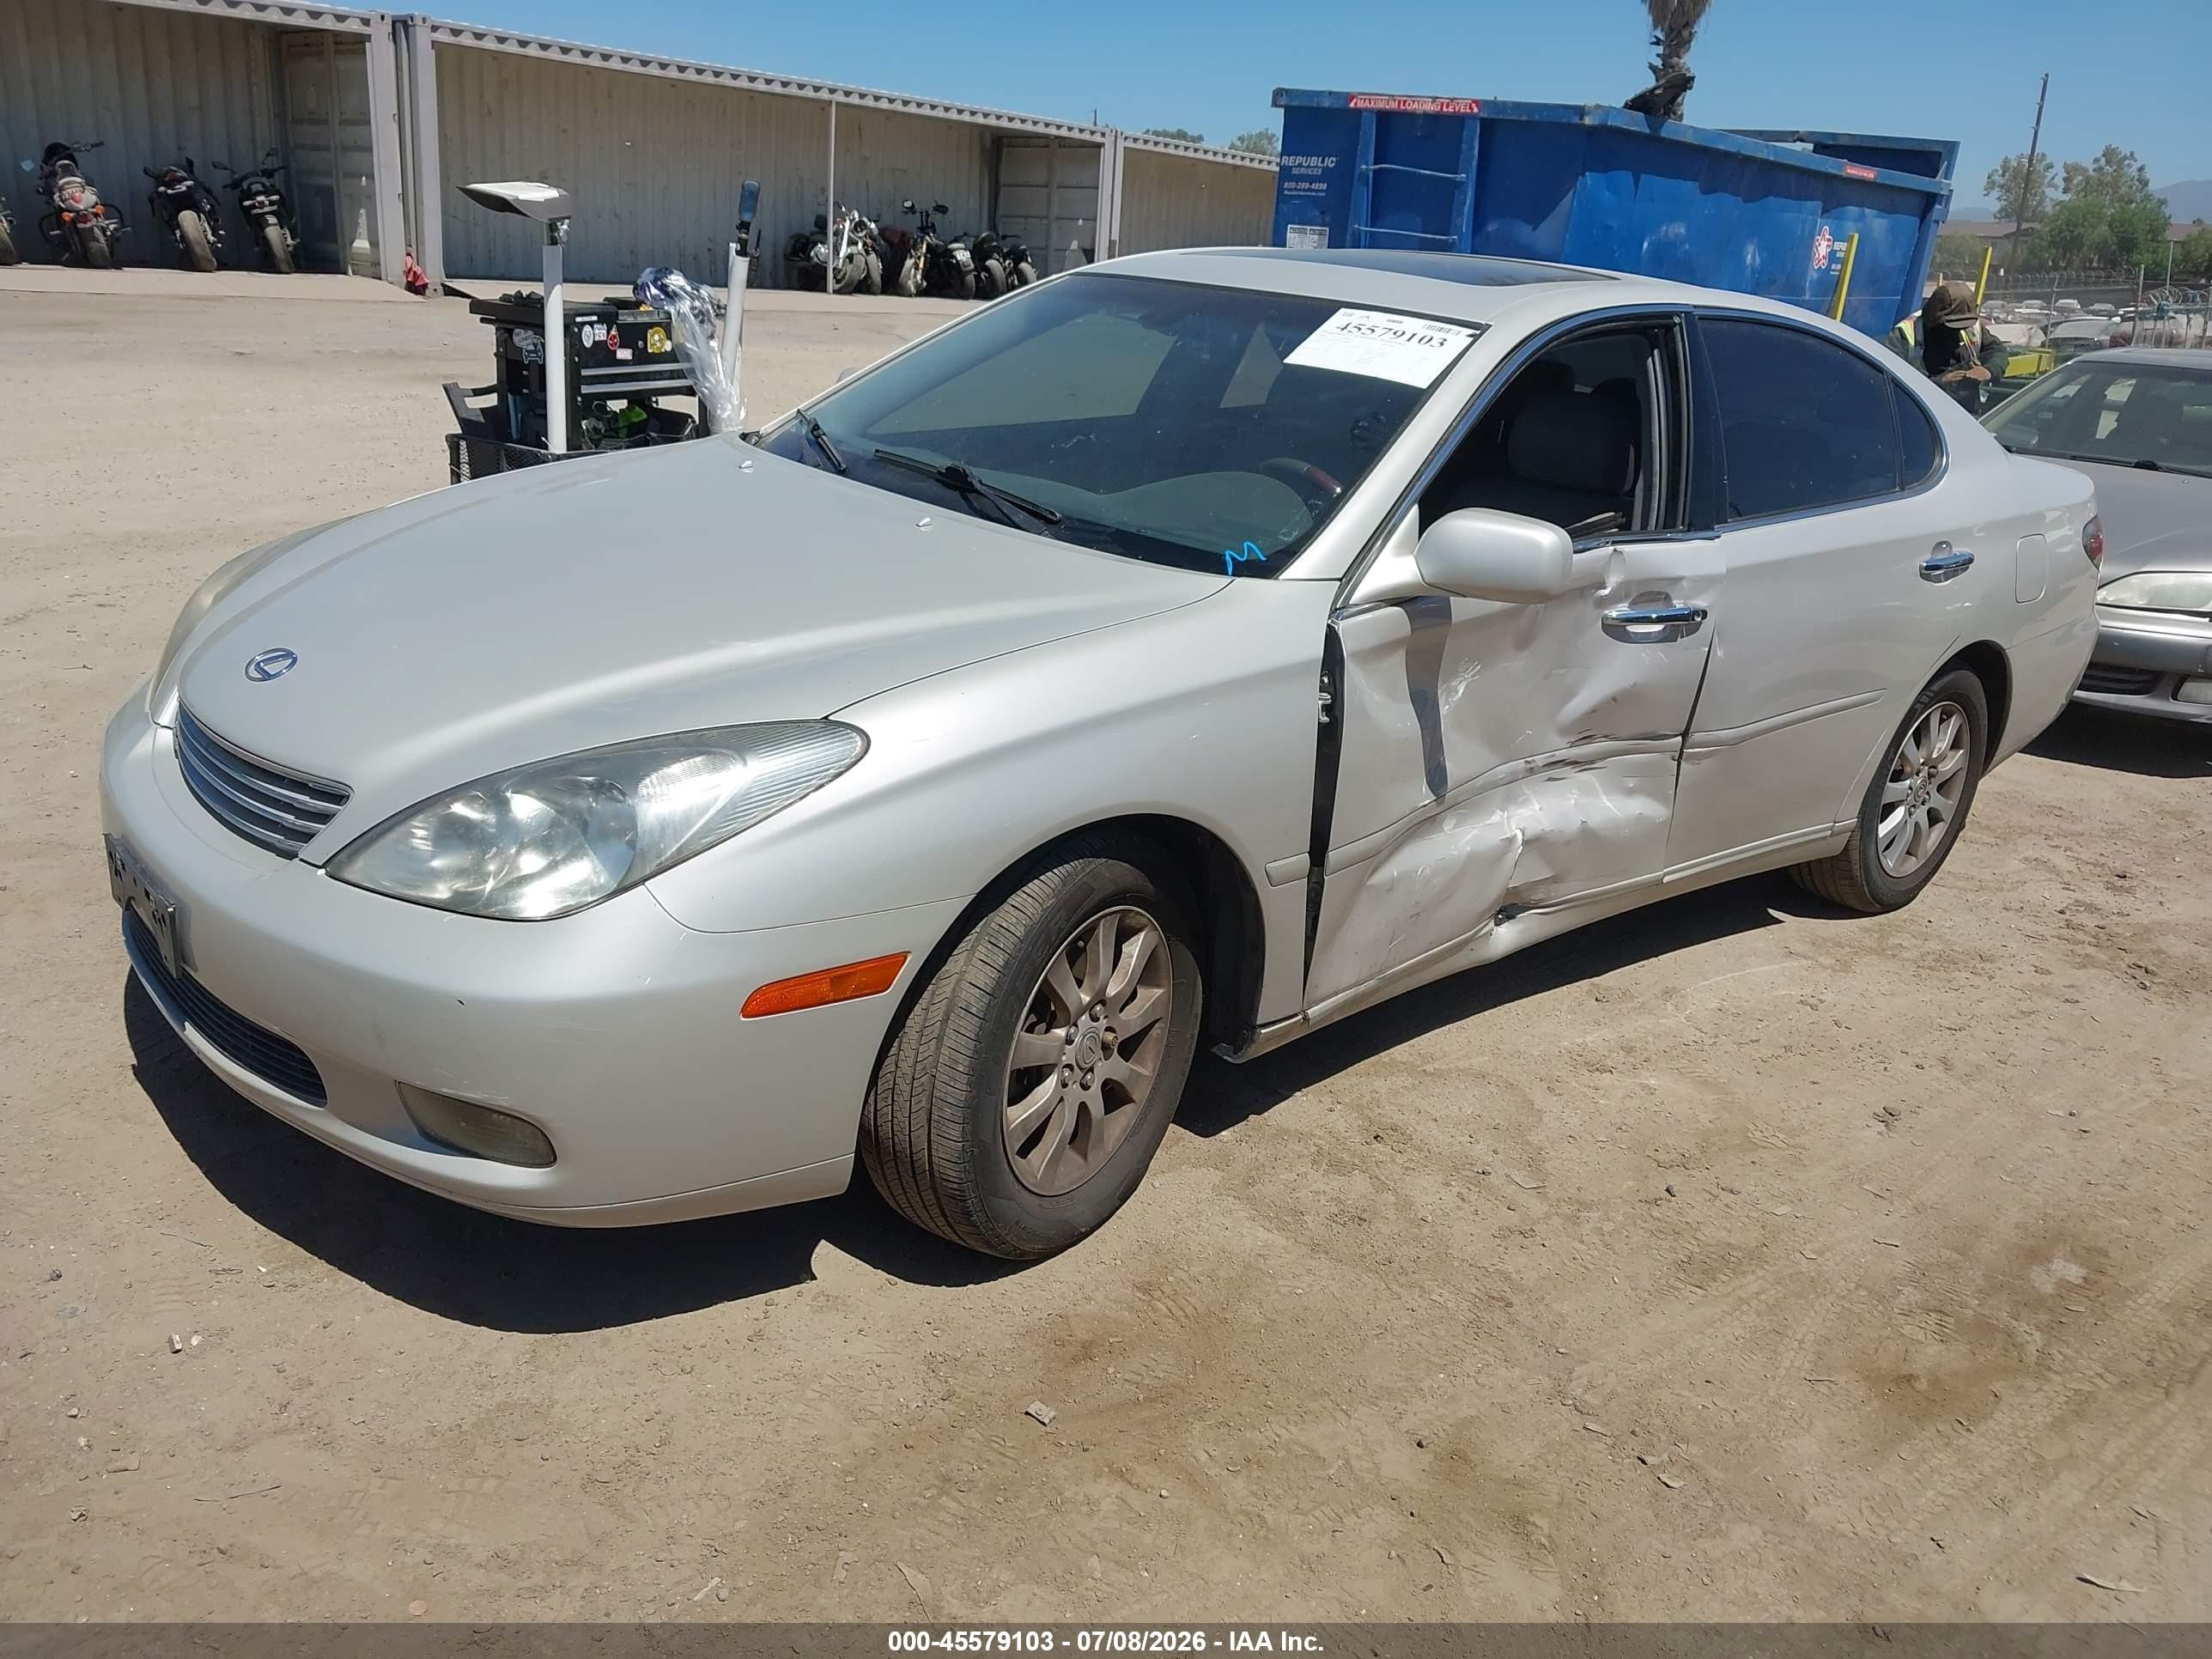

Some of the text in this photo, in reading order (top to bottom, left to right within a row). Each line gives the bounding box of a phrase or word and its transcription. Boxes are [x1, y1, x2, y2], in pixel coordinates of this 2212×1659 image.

[1358, 97, 1399, 109] MAXIMUM
[1401, 100, 1441, 111] LOADING
[1281, 155, 1336, 167] REPUBLIC
[1291, 167, 1322, 175] SERVICES
[1336, 321, 1448, 348] 45579103
